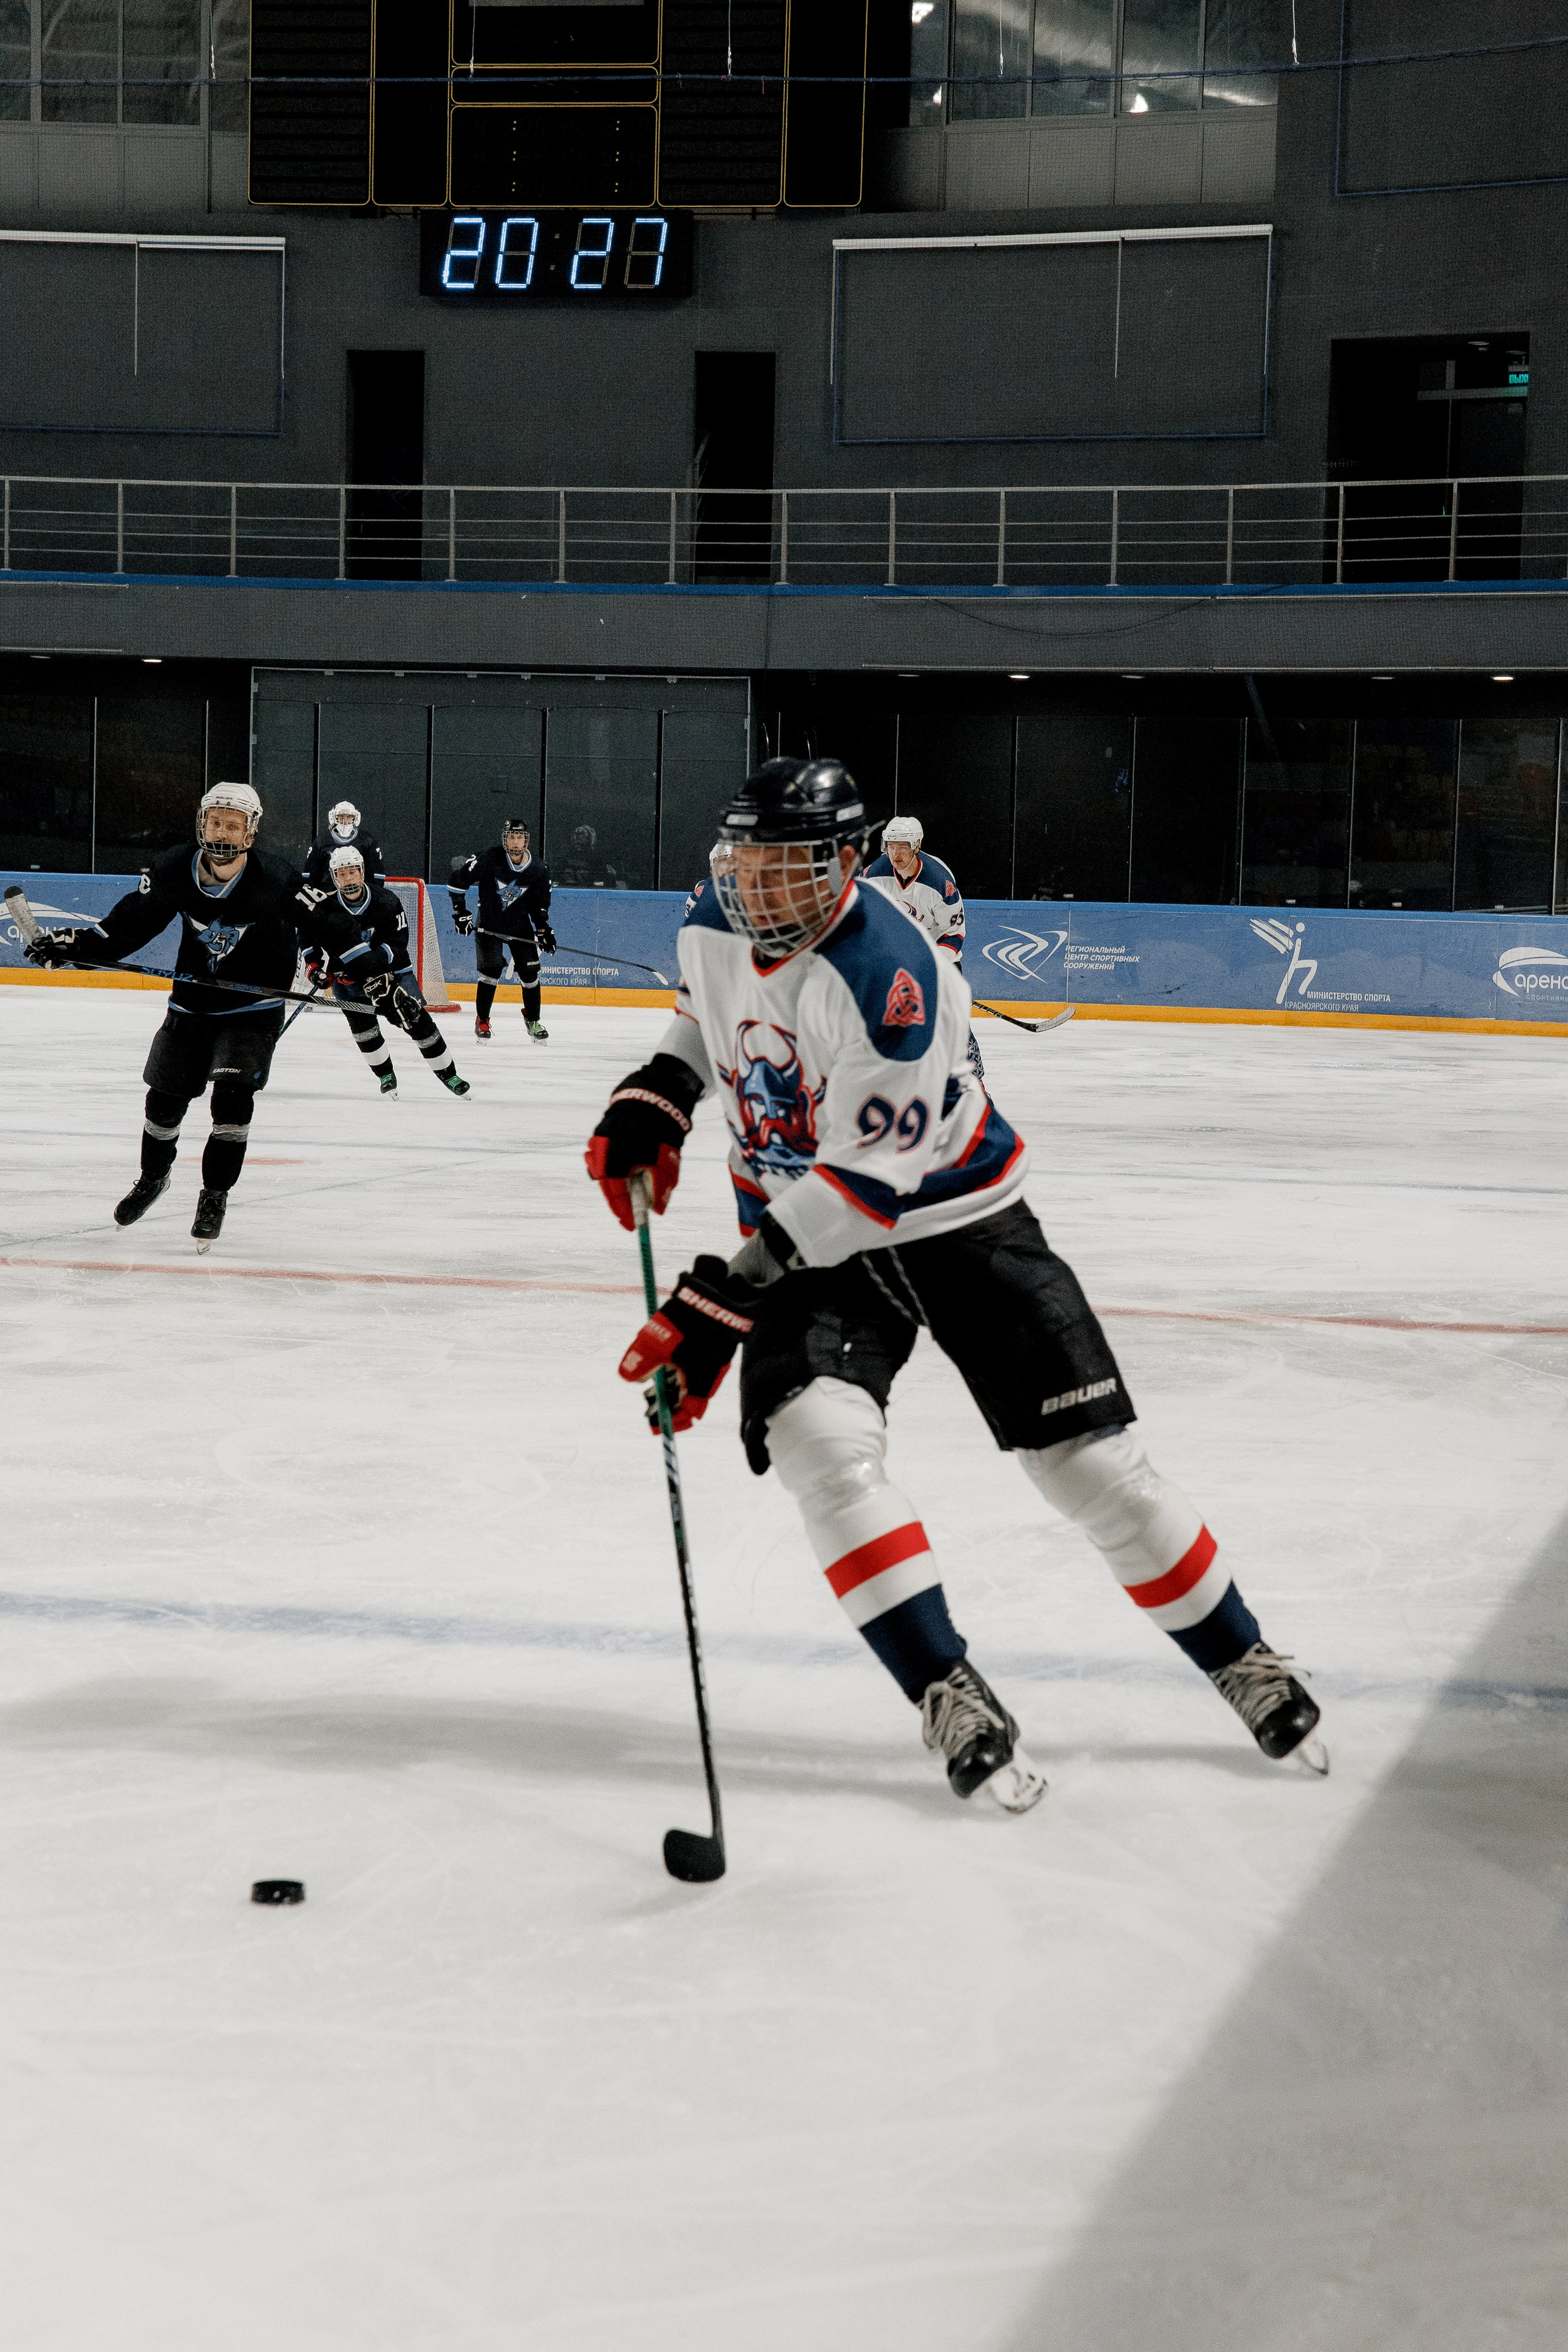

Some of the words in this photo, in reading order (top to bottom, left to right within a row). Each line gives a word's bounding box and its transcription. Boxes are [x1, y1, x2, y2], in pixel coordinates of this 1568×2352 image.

[442, 217, 539, 289] 20
[570, 217, 668, 289] 27
[1065, 945, 1126, 954] РЕГИОНАЛЬНЫЙ
[538, 966, 590, 975] ИНИСТЕРСТВО
[592, 967, 619, 976] СПОРТА
[1306, 991, 1362, 1001] МИНИСТЕРСТВО
[1364, 993, 1391, 1002] СПОРТА
[1284, 1001, 1340, 1011] КРАСНОЯРСКОГО
[855, 1092, 931, 1154] 99
[1041, 1377, 1117, 1416] BAUER
